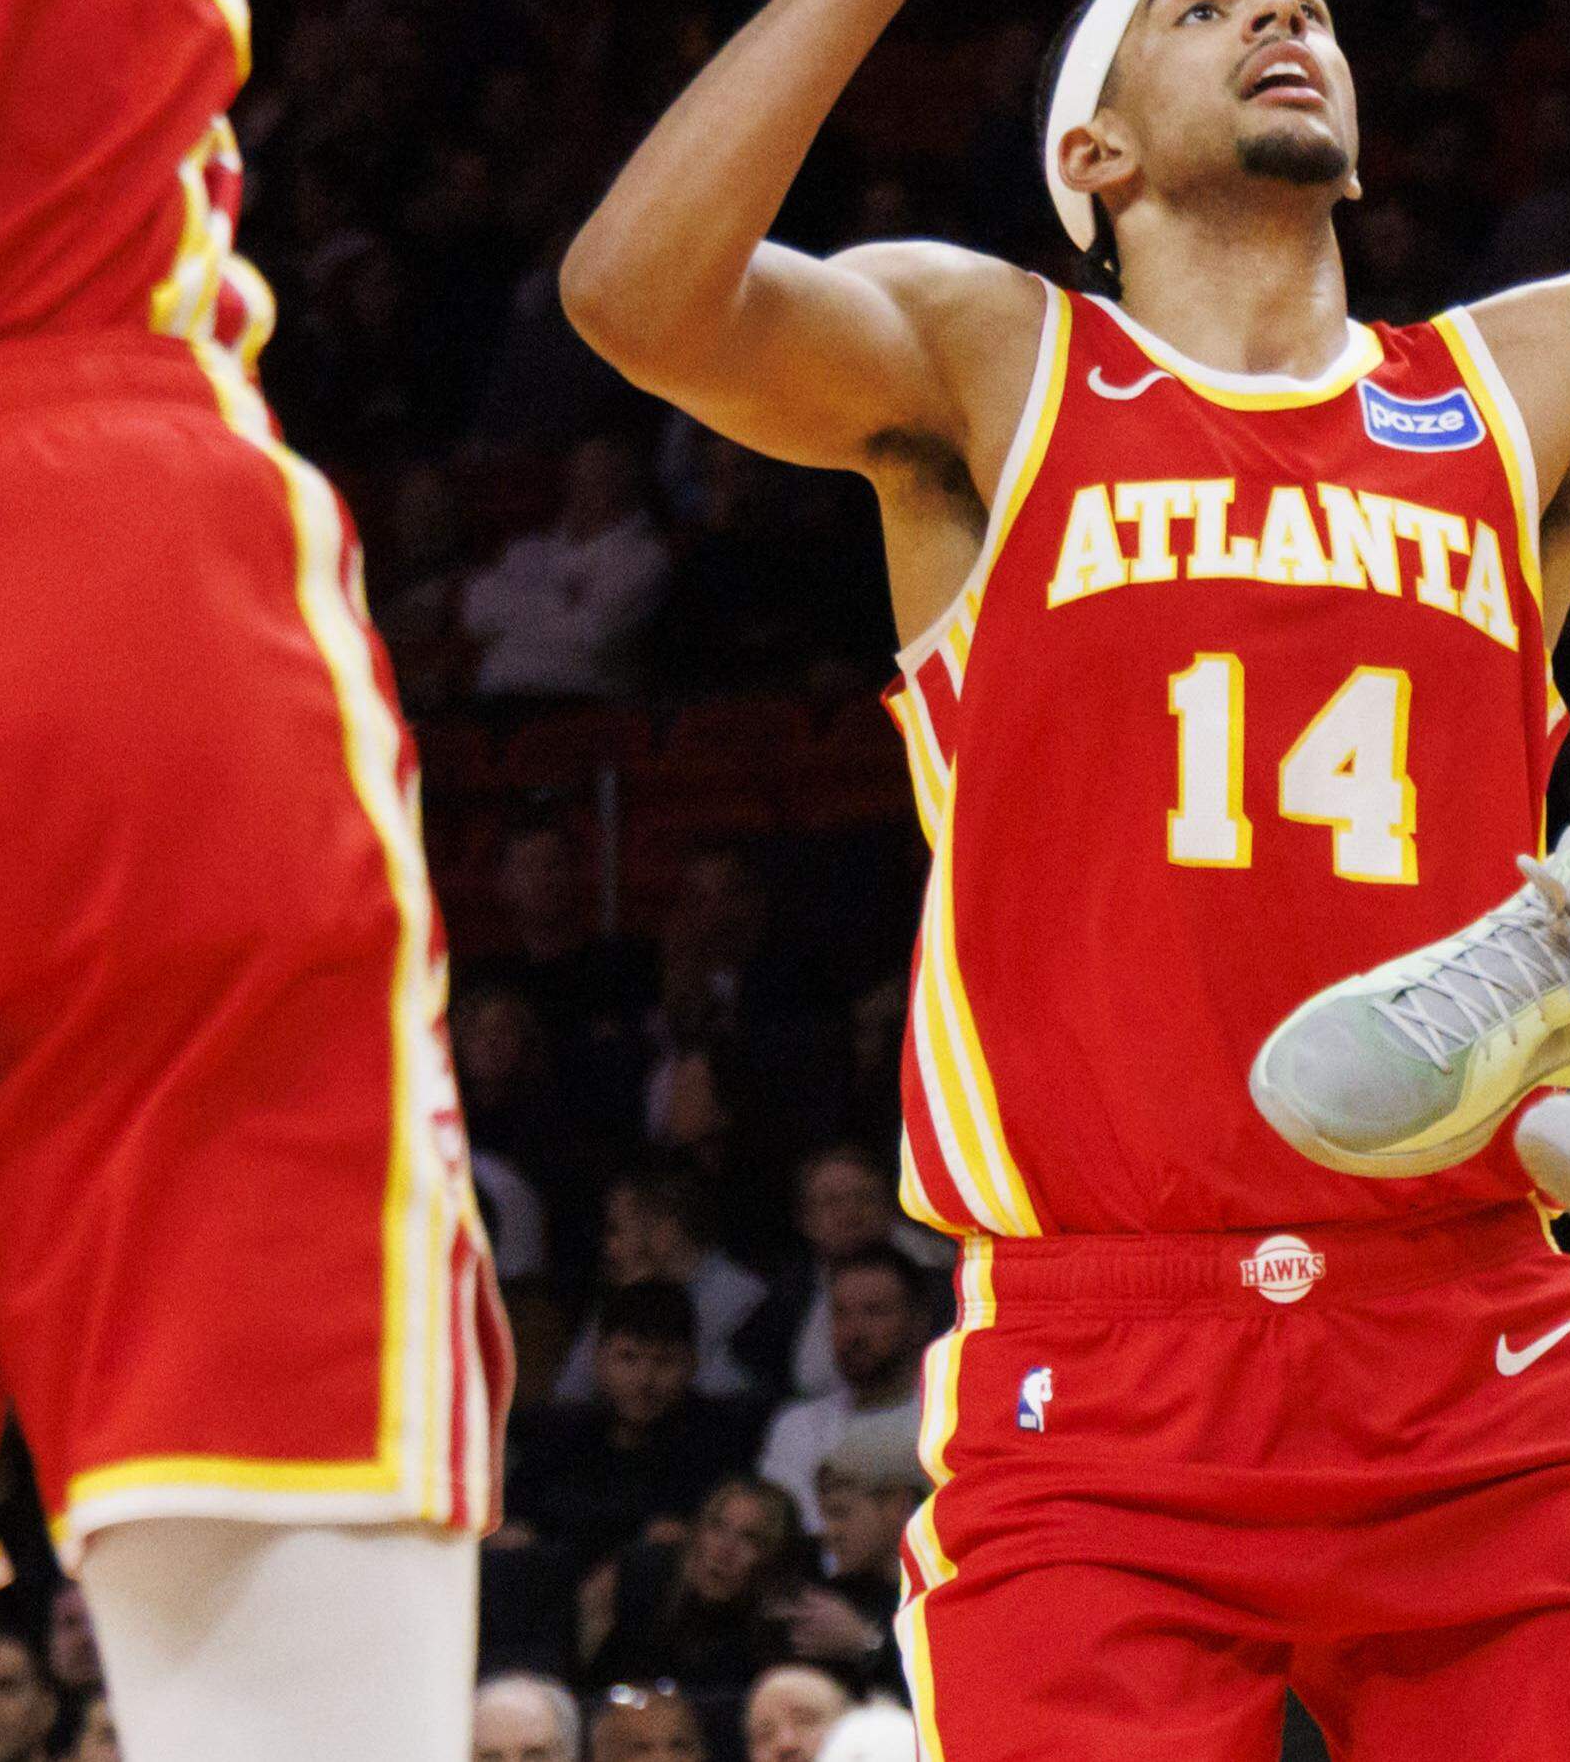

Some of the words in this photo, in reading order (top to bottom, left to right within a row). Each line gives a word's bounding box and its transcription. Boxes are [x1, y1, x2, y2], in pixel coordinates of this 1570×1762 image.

[1368, 400, 1465, 434] paze
[1047, 477, 1519, 653] ATLANTA
[1167, 652, 1419, 886] 14
[1243, 1255, 1326, 1285] HAWKS
